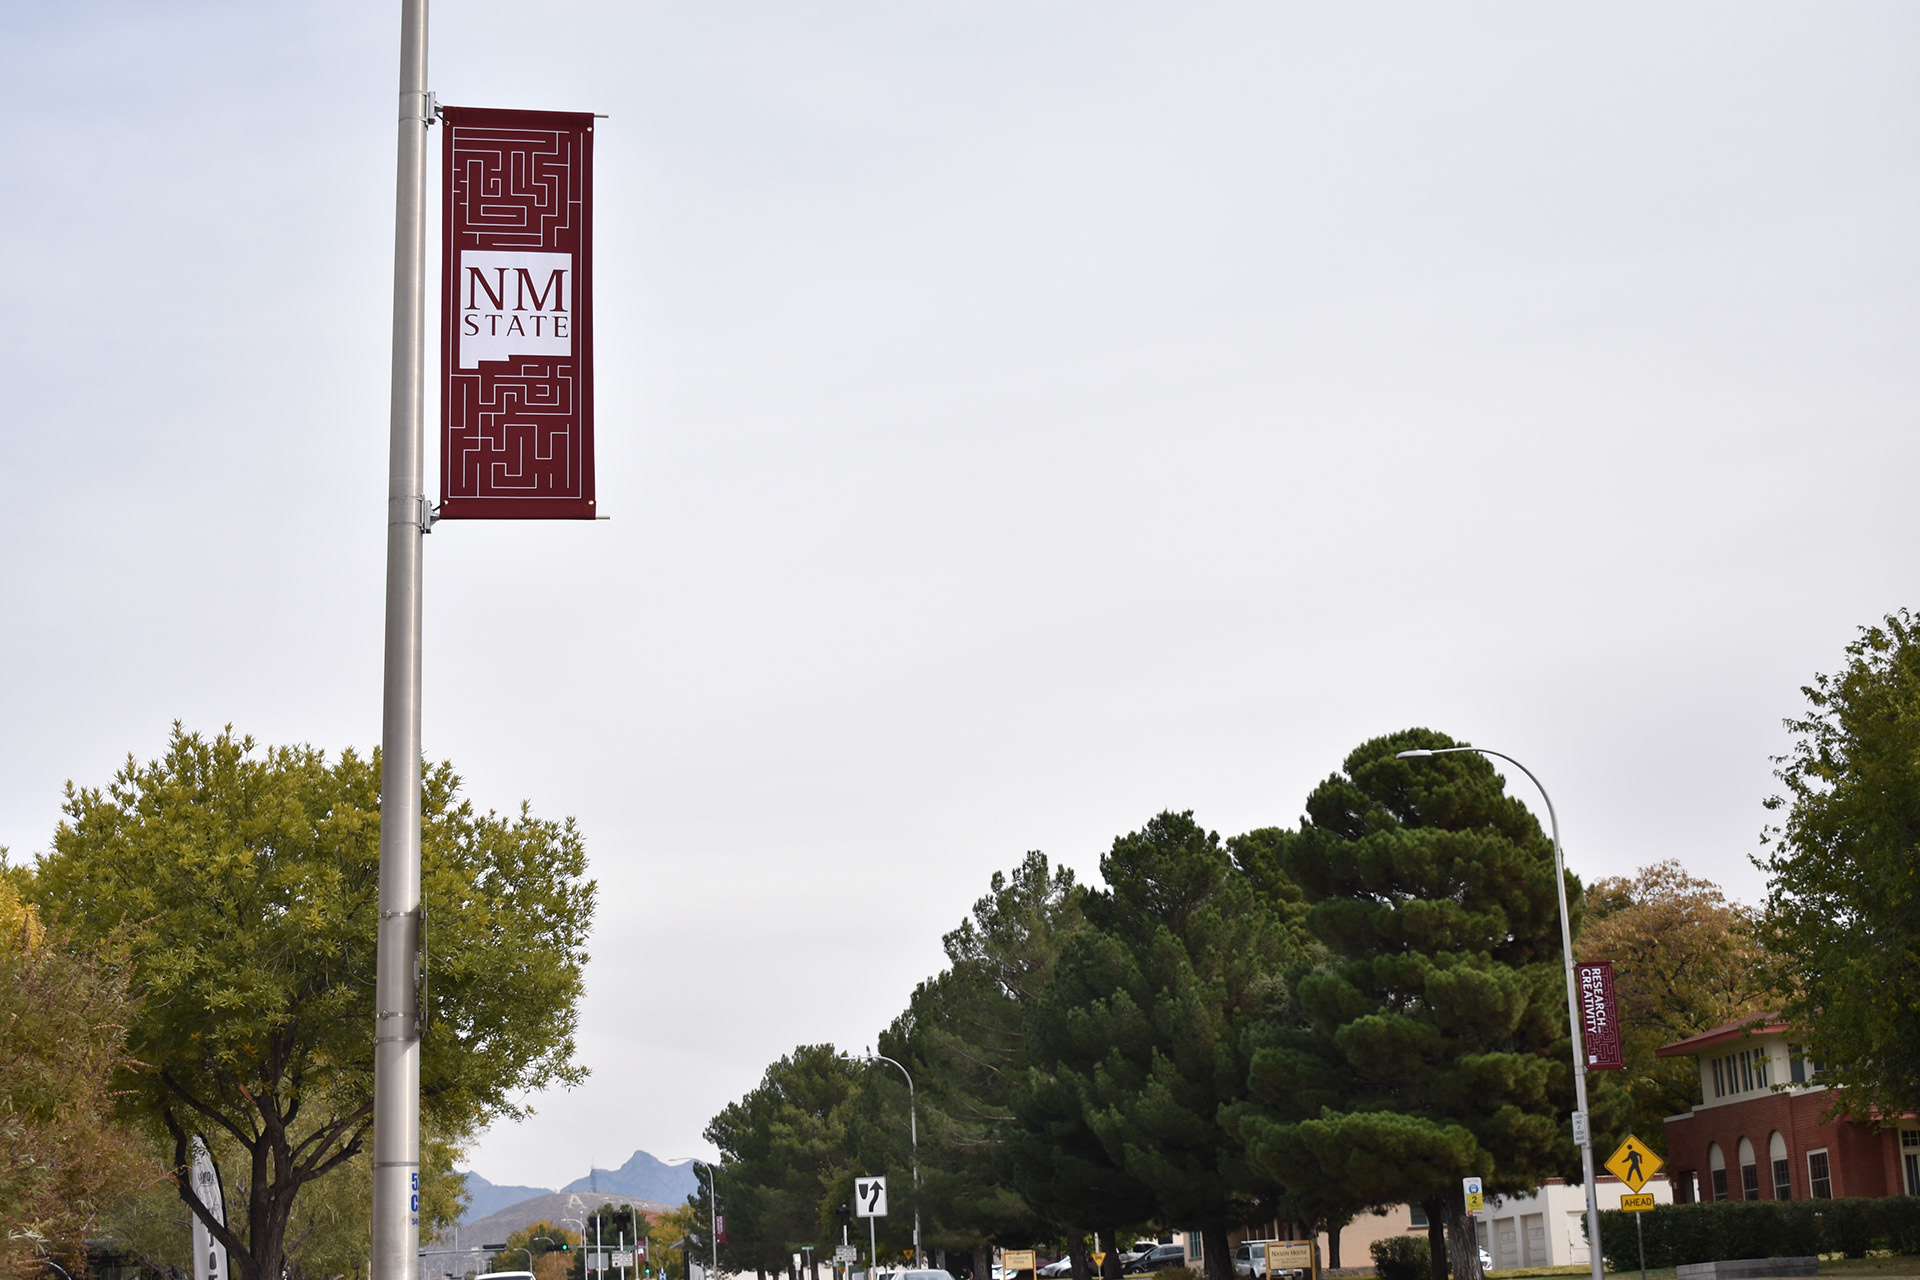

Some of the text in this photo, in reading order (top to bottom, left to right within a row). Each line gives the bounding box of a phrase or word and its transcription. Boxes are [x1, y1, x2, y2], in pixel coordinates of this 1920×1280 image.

[464, 266, 569, 313] NM
[464, 313, 569, 338] STATE
[1581, 968, 1597, 1034] CREATIVITY
[1591, 967, 1607, 1026] RESEARCH
[1471, 1195, 1478, 1204] 2
[1624, 1197, 1652, 1207] AHEAD
